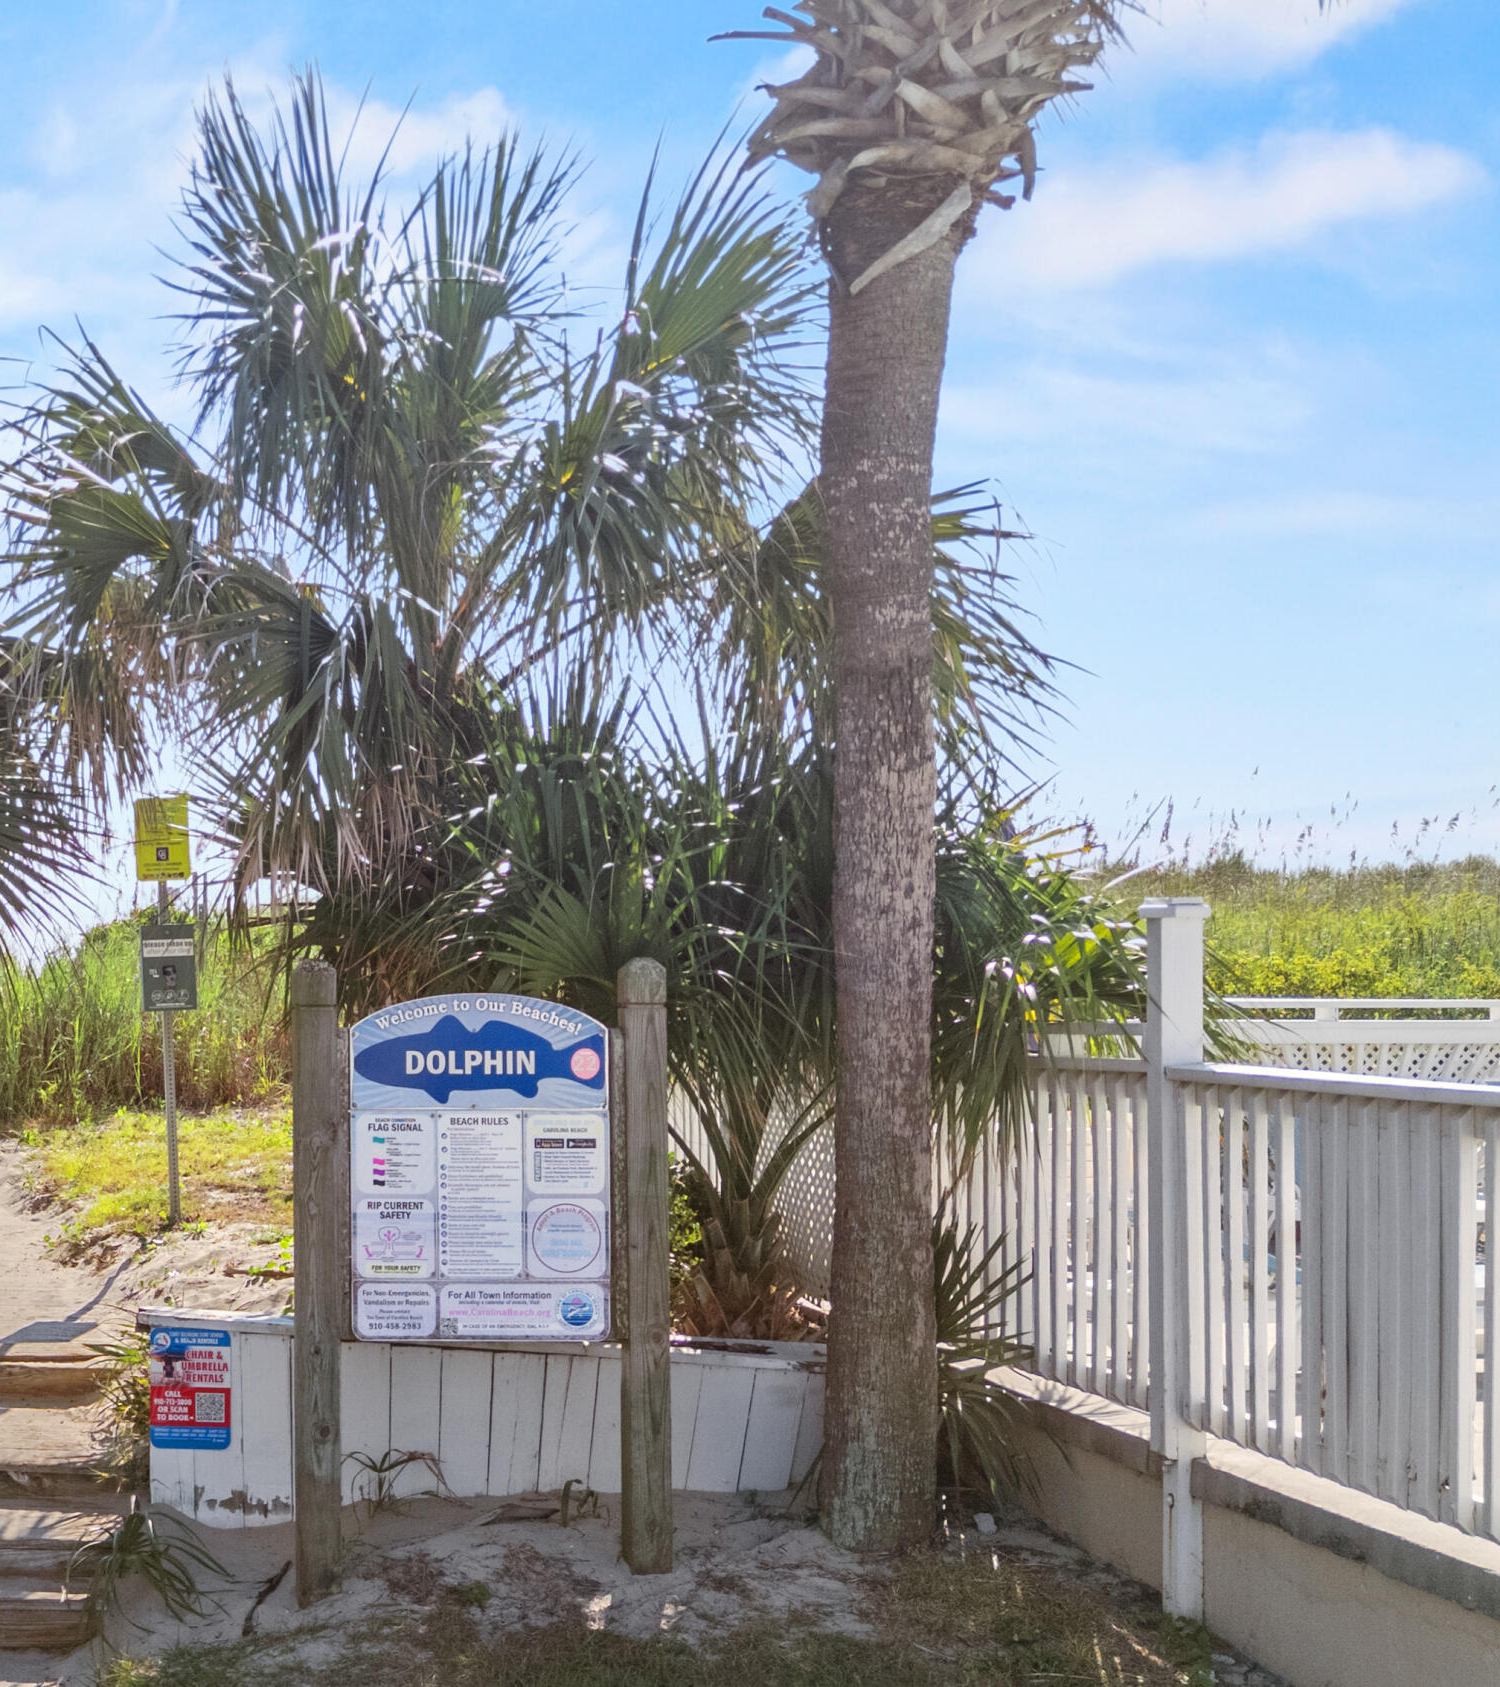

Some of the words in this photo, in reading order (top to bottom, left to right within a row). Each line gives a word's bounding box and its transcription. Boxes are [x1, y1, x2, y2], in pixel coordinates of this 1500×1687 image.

[375, 1002, 448, 1030] Welcome
[453, 999, 470, 1011] to
[475, 998, 506, 1012] Our
[510, 1001, 582, 1035] Beaches!
[405, 1050, 536, 1075] DOLPHIN
[574, 1055, 597, 1072] 22
[450, 1117, 479, 1125] BEACH
[481, 1117, 509, 1125] RULES
[368, 1123, 389, 1131] FLAG
[391, 1123, 423, 1131] SIGNAL
[367, 1201, 381, 1210] RIP
[383, 1201, 424, 1210] CURRENT
[380, 1211, 411, 1219] SAFETY
[448, 1291, 462, 1299] For
[464, 1291, 476, 1299] All
[478, 1291, 501, 1299] Town
[503, 1291, 552, 1299] Information
[185, 1350, 214, 1360] CHAIR
[216, 1351, 223, 1360] &
[182, 1362, 229, 1372] UMBRELLA
[185, 1373, 224, 1383] RENTALS
